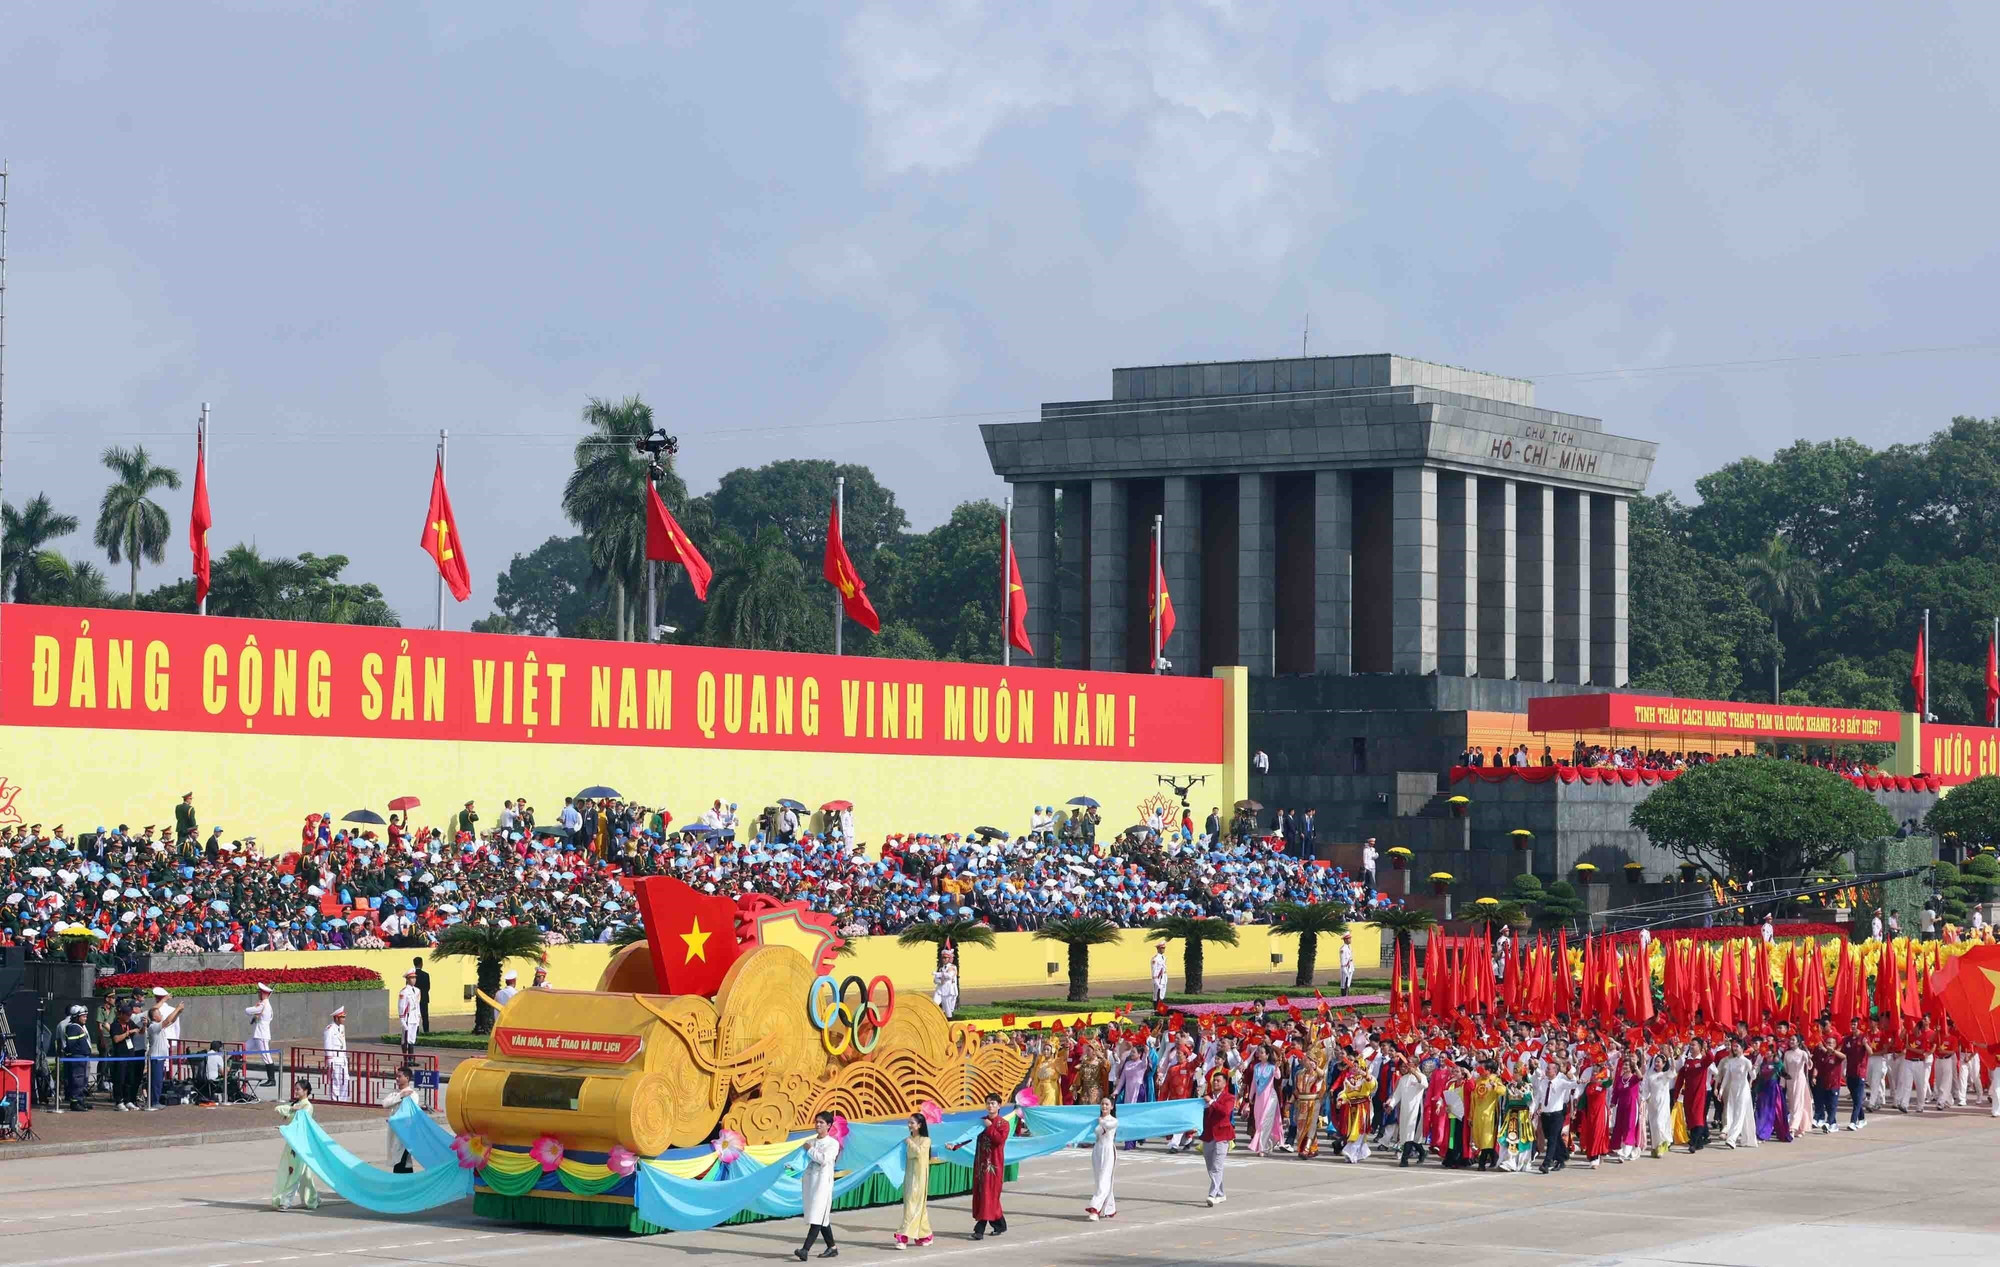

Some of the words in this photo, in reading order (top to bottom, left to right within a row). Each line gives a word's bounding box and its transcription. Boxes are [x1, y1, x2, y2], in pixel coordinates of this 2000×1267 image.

[32, 619, 170, 712] ĐẢNG
[202, 634, 332, 729] CỘNG
[361, 639, 446, 722] SẢN
[472, 650, 566, 738] VIỆT
[590, 666, 673, 731] NAM
[696, 670, 820, 739] QUANG
[841, 679, 924, 740] VINH
[944, 678, 1034, 744] MUÔN
[1053, 682, 1115, 746] NĂM
[1634, 705, 1657, 724] TINH
[1657, 702, 1680, 725] THẦN
[1681, 705, 1703, 727] CÁCH
[1704, 710, 1727, 730] MẠNG
[1728, 709, 1755, 730] THÁNG
[1756, 711, 1773, 731] TÁM
[1774, 711, 1785, 731] VÀ
[1785, 711, 1805, 733] QUỐC
[1806, 713, 1831, 733] KHÁNH
[1832, 717, 1846, 734] 2-9
[1846, 714, 1861, 735] BẤT
[1934, 732, 1972, 777] NƯỚC
[1979, 734, 2000, 777] CÔ
[511, 1034, 527, 1046] VĂN
[527, 1035, 544, 1049] HÓA,
[547, 1035, 561, 1049] THỂ
[561, 1038, 580, 1050] THAO
[581, 1039, 590, 1051] VÀ
[592, 1041, 602, 1051] DU
[603, 1042, 621, 1054] LỊCH
